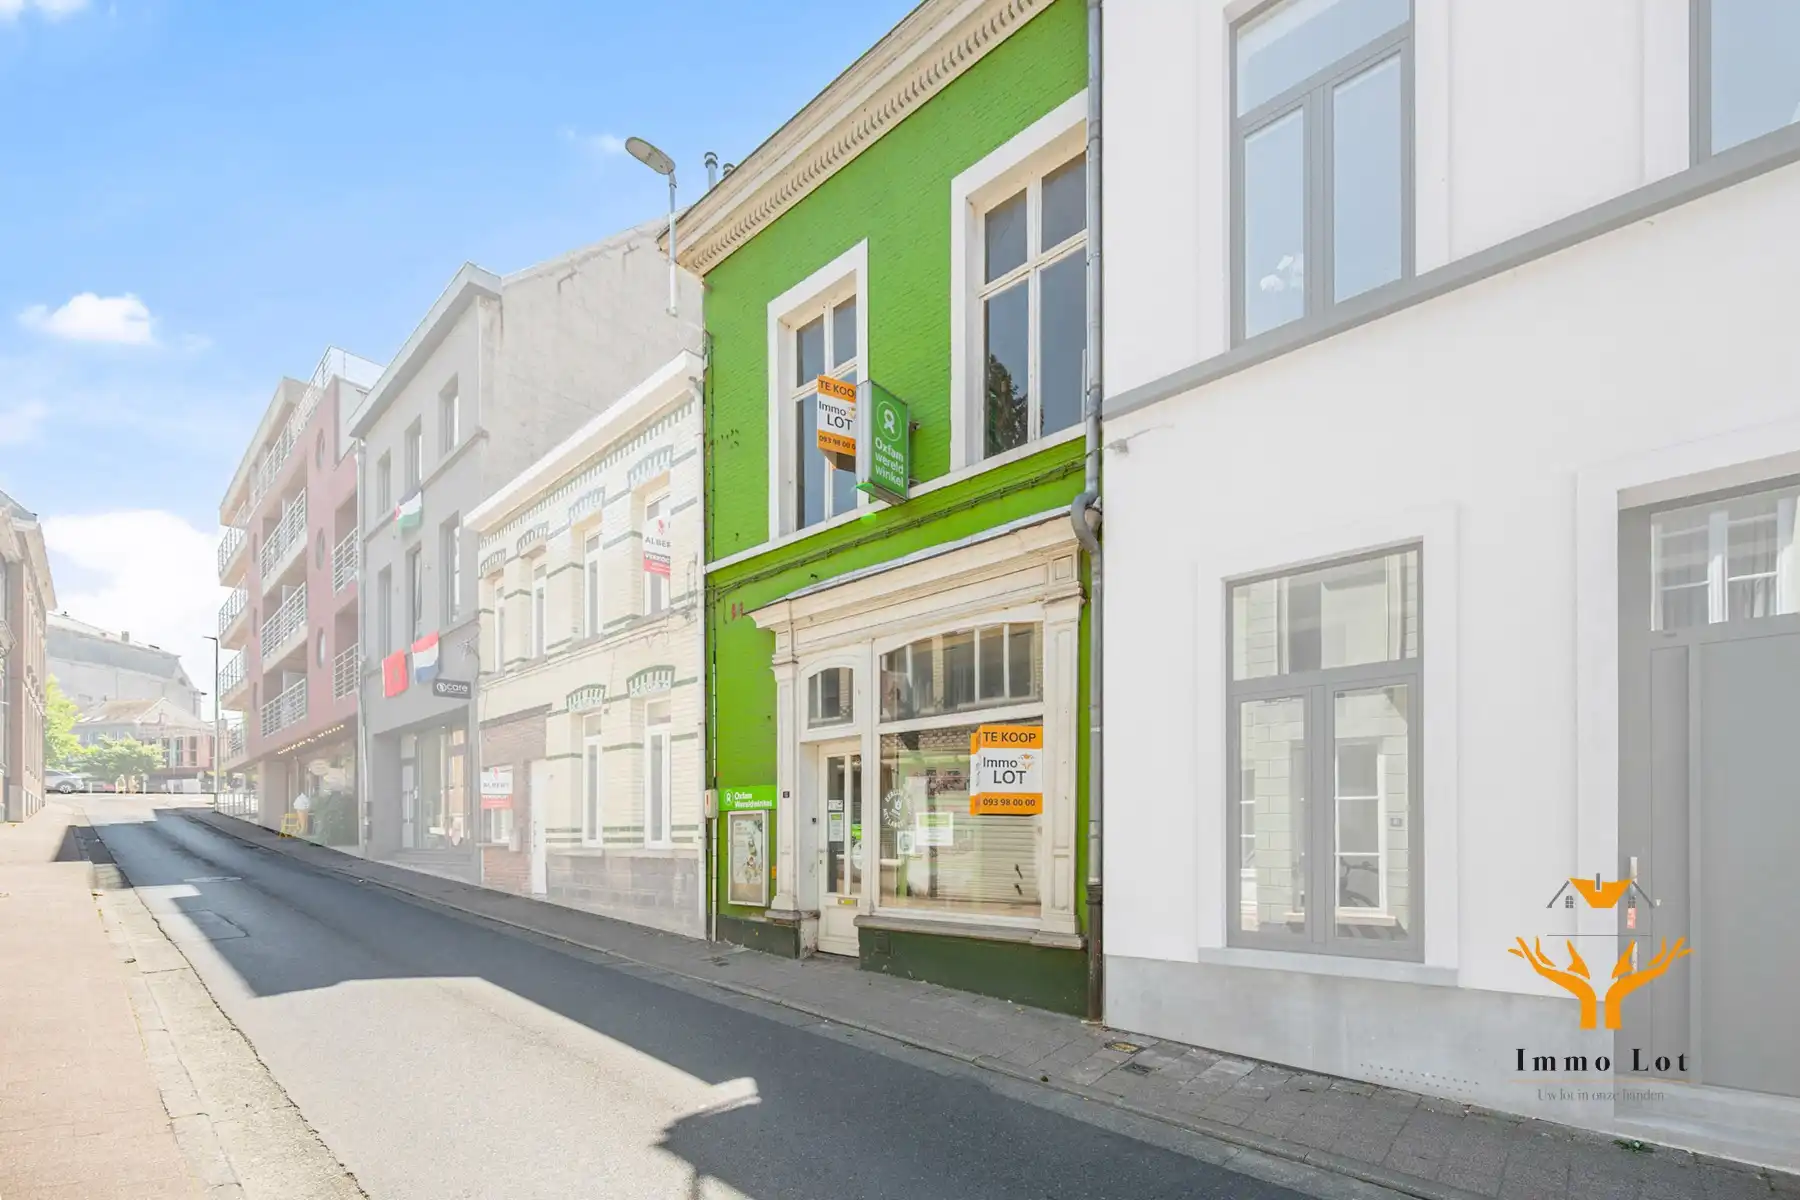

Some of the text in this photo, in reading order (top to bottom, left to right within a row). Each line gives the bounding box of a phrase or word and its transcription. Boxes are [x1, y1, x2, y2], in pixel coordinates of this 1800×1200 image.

[819, 379, 857, 400] TE KOO
[818, 401, 847, 416] Immo
[827, 414, 853, 430] LOT
[875, 437, 904, 463] Oxfam
[875, 452, 904, 474] wereld
[875, 464, 904, 487] winkel
[983, 732, 1036, 743] TE KOOP
[983, 757, 1018, 768] Immo
[993, 770, 1026, 784] LOT
[734, 791, 753, 800] Oxfam
[983, 798, 998, 806] 093
[1000, 798, 1011, 806] 98
[1025, 799, 1036, 807] 00
